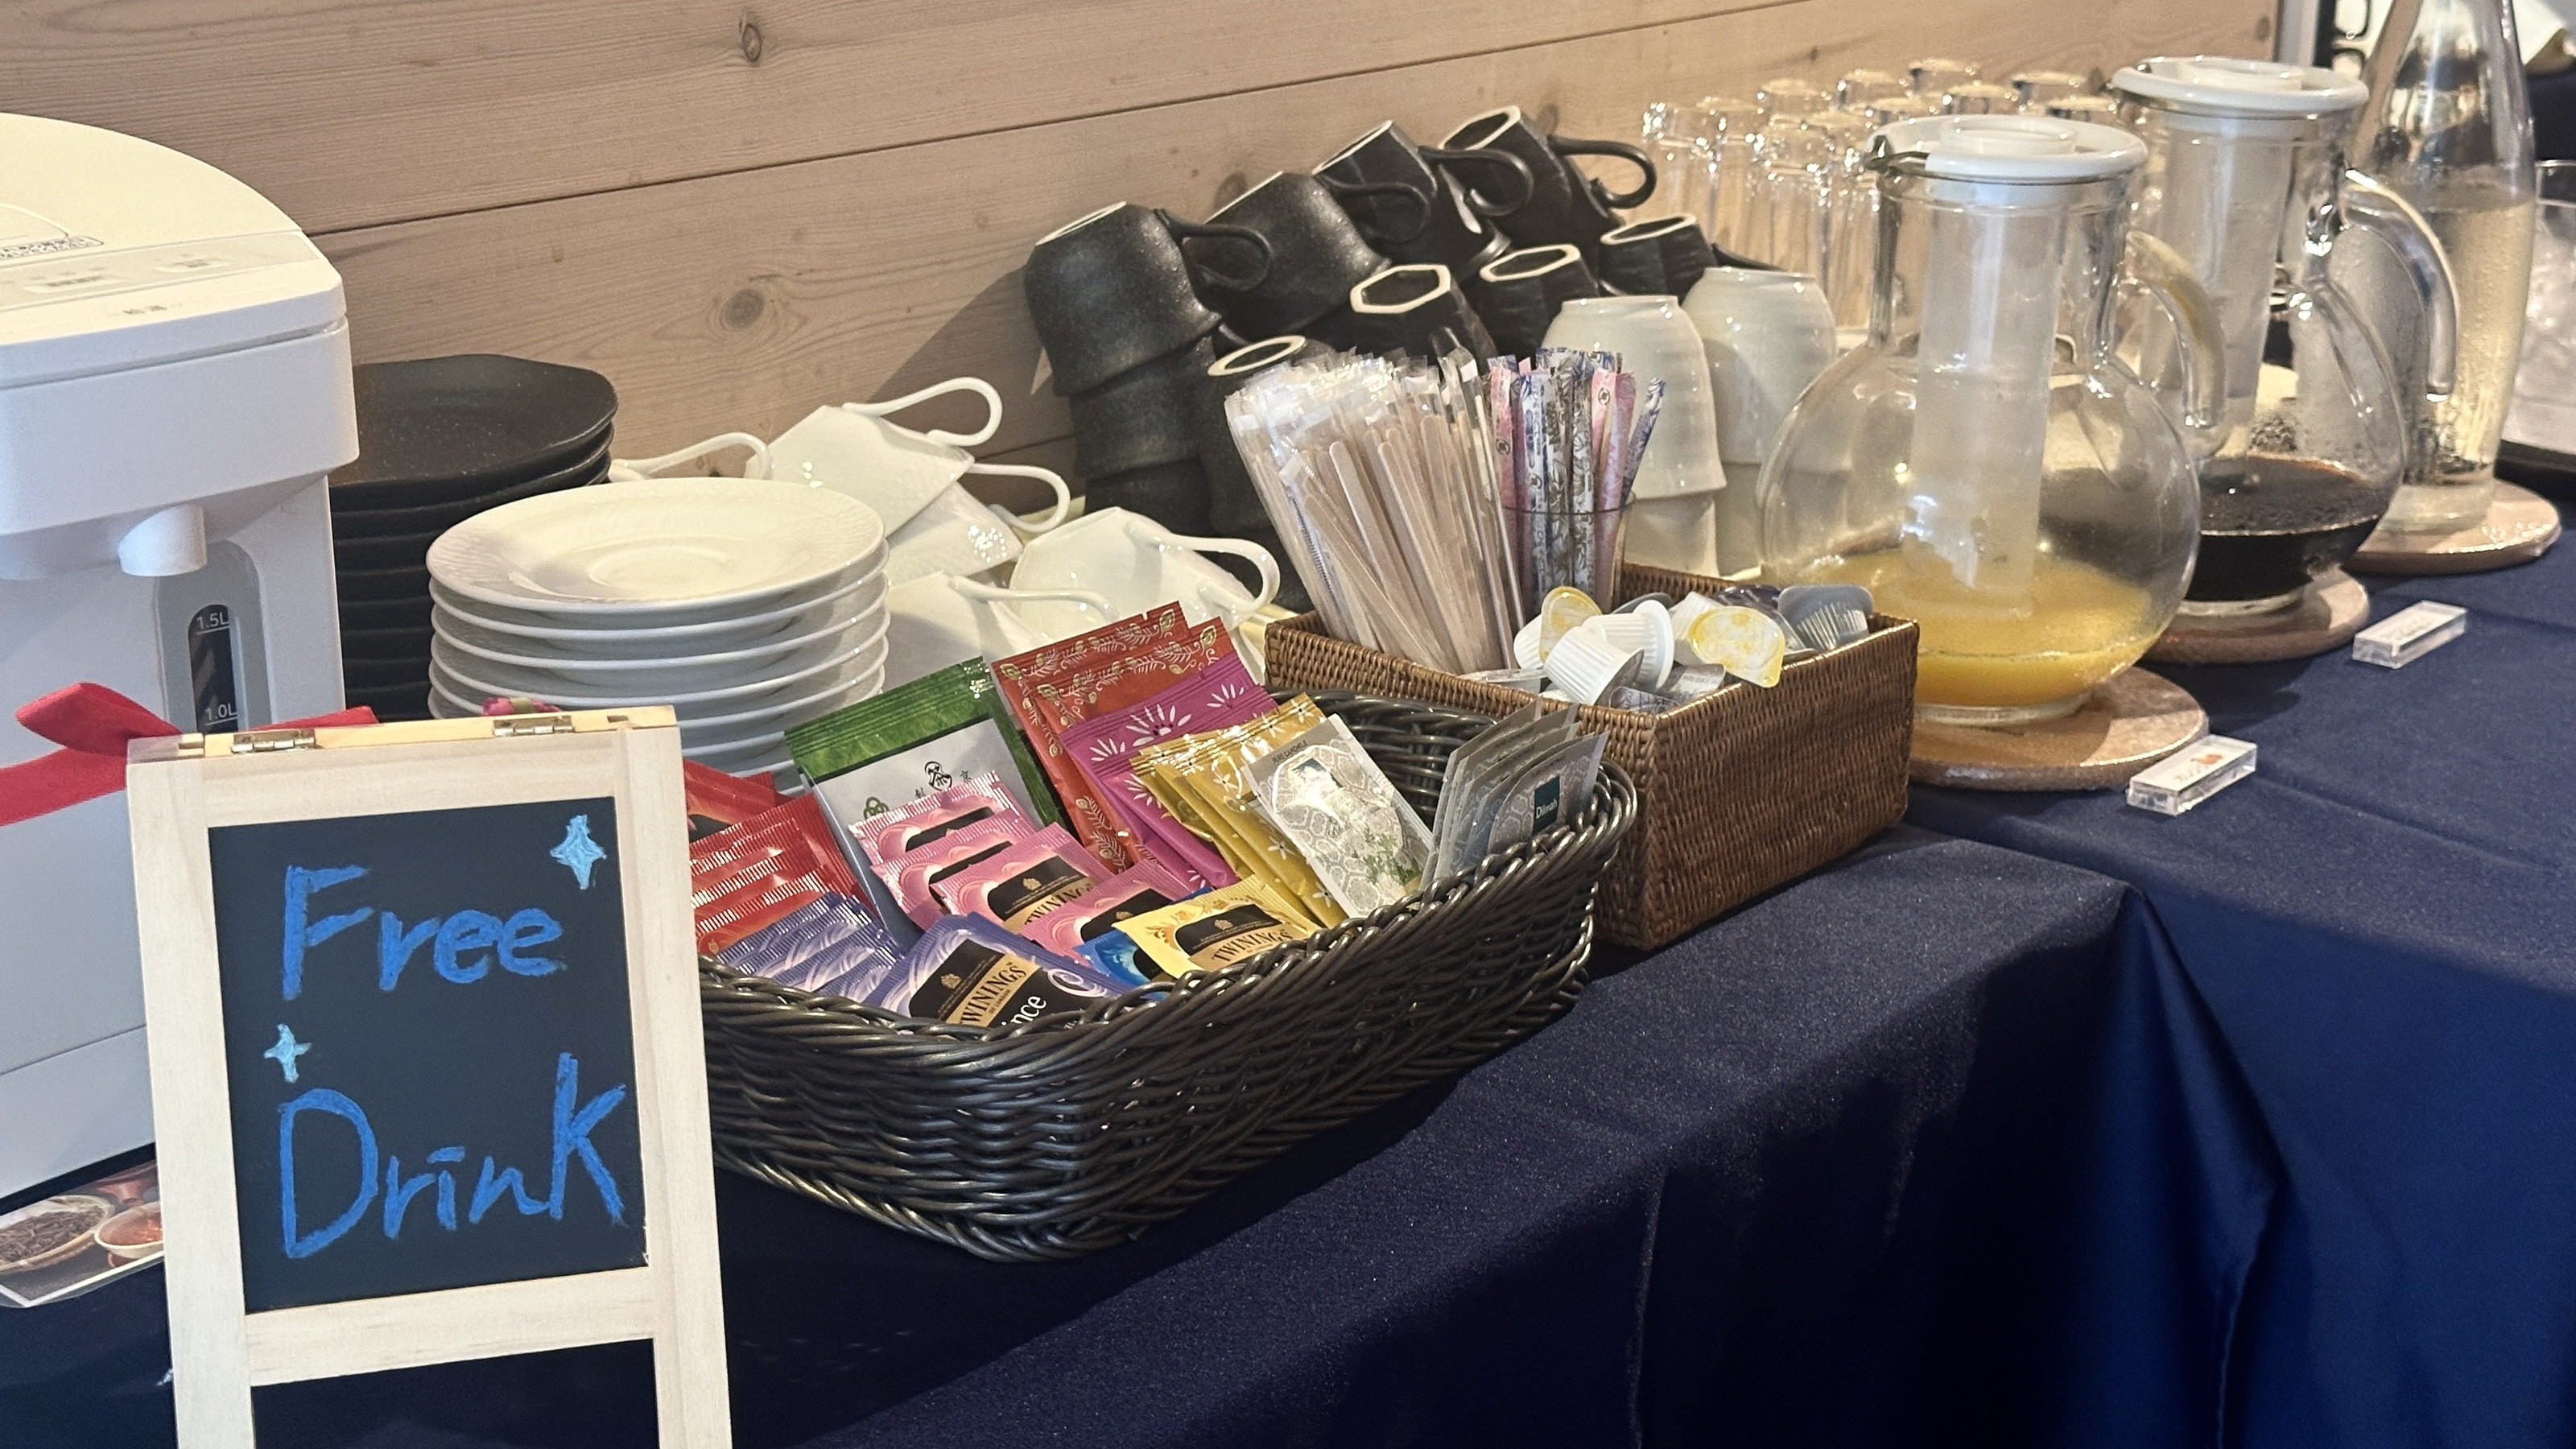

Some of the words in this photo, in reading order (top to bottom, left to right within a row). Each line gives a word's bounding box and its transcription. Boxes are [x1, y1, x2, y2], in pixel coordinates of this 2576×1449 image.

[196, 612, 229, 630] 1.5L
[204, 703, 237, 721] 1.0L
[281, 864, 567, 1001] Free
[1212, 930, 1293, 962] TWININGS
[960, 964, 1026, 1024] WININGS
[279, 1052, 628, 1259] Drink
